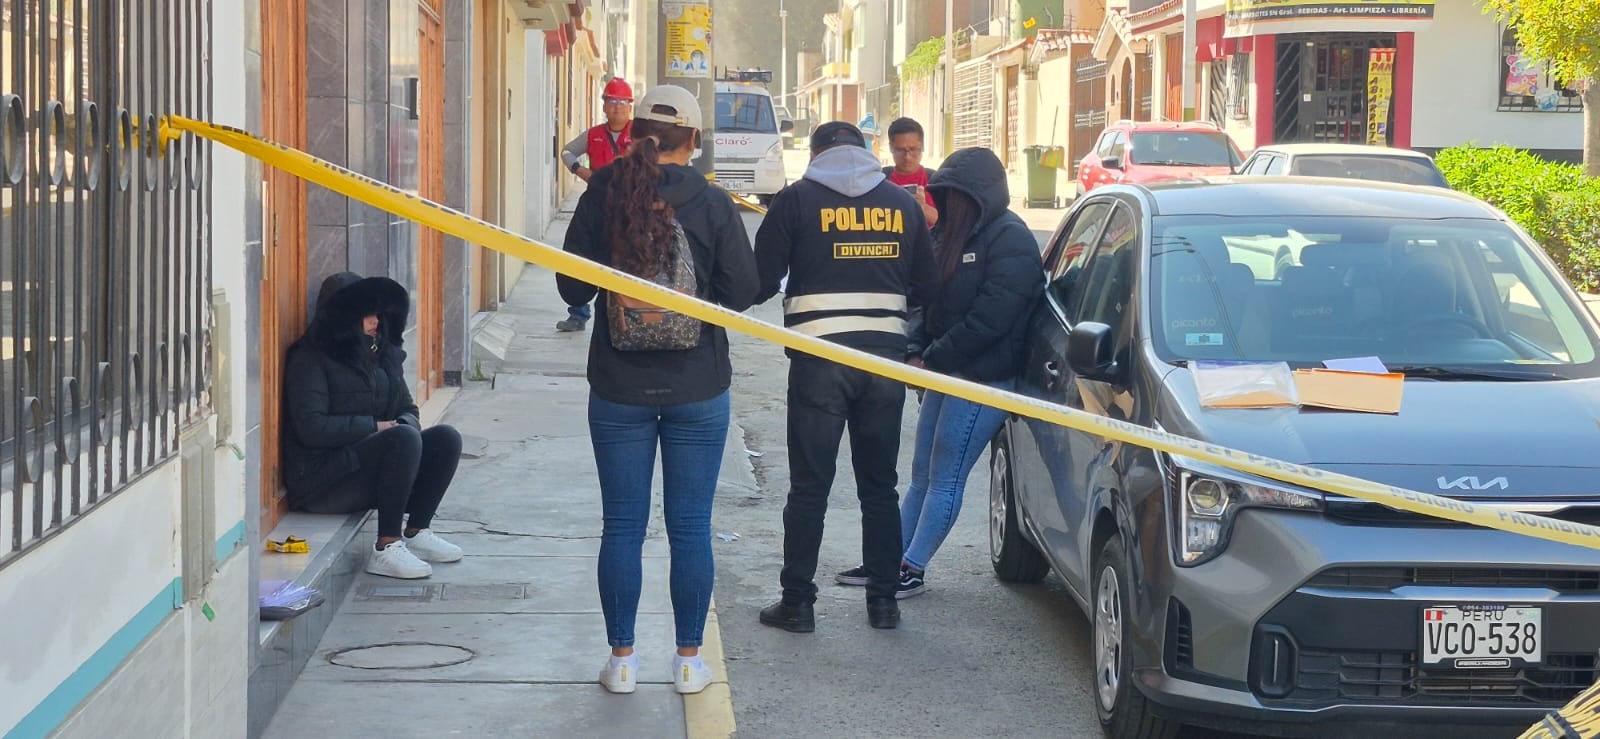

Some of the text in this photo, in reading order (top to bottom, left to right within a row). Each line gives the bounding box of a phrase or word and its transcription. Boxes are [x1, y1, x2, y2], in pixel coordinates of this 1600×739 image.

[1370, 62, 1393, 72] PAN
[840, 245, 893, 256] DIVINCRI
[1436, 475, 1509, 491] KIA
[1462, 610, 1504, 621] PERU
